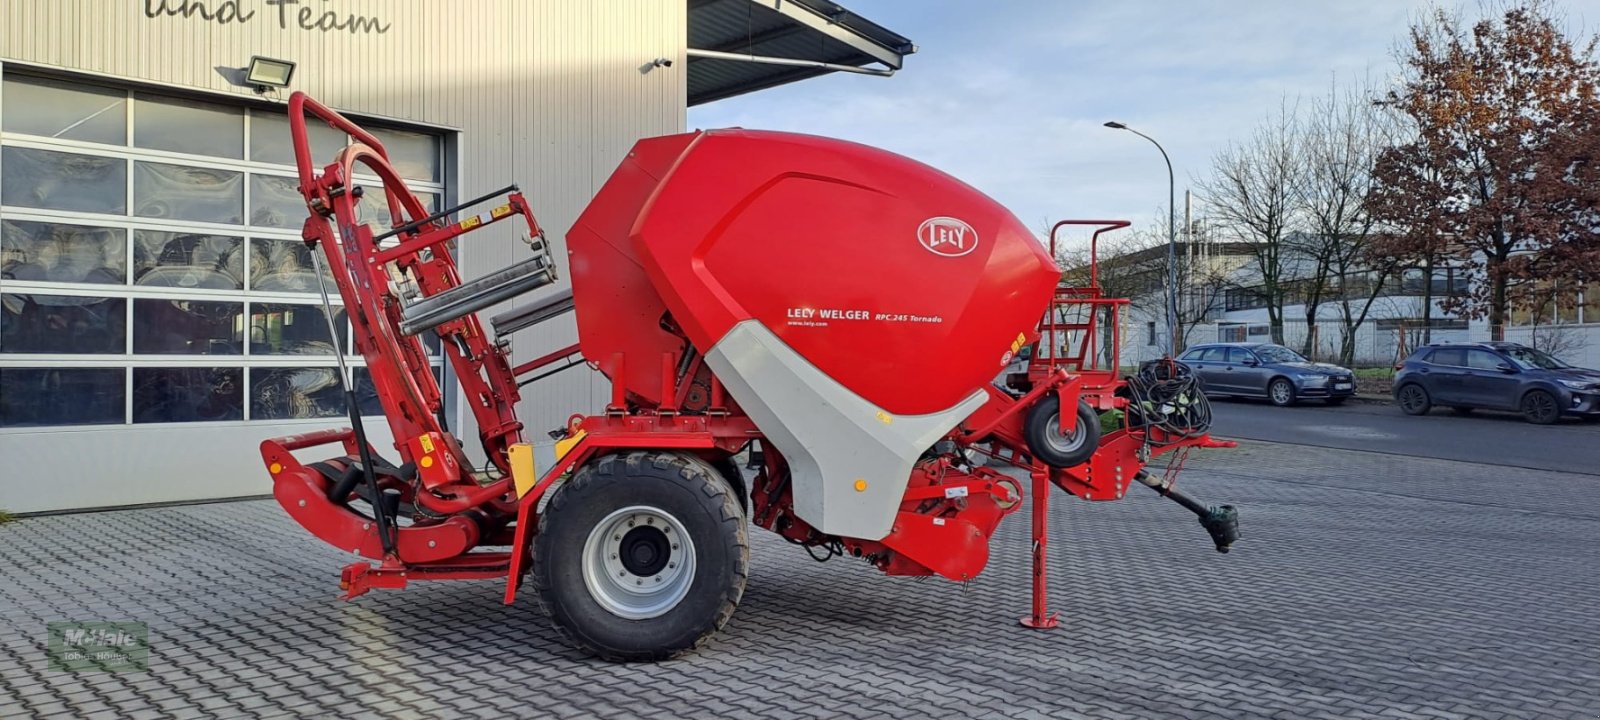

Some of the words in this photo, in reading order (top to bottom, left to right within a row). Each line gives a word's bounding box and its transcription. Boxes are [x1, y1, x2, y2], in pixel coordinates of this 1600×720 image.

[266, 0, 391, 34] Team
[930, 223, 965, 250] LELY
[787, 308, 816, 318] LELY
[819, 309, 870, 320] WELGER
[910, 315, 943, 323] Tornado
